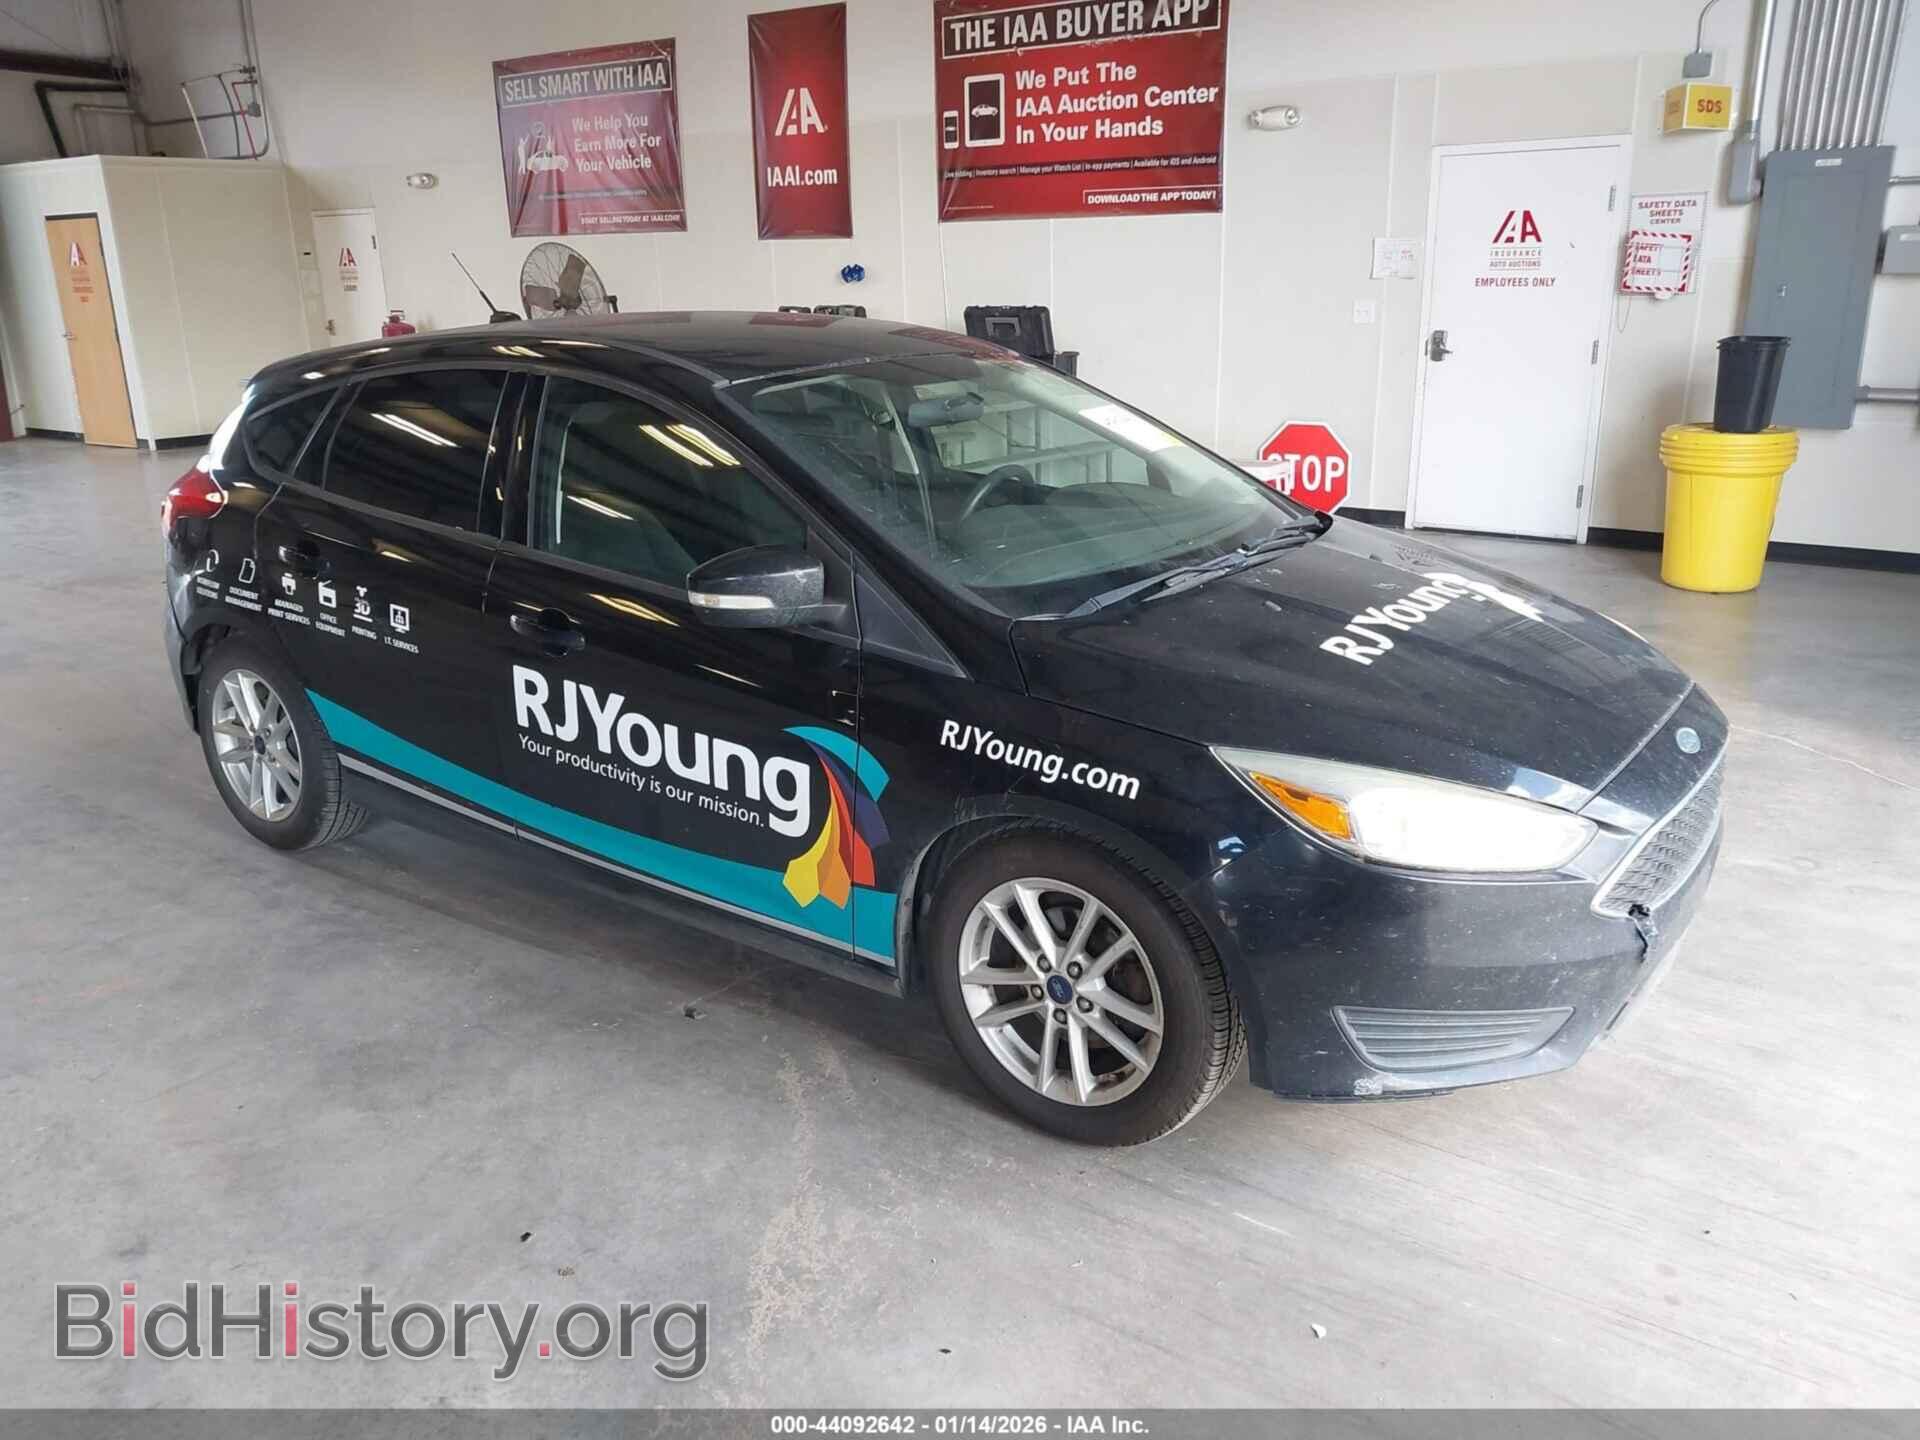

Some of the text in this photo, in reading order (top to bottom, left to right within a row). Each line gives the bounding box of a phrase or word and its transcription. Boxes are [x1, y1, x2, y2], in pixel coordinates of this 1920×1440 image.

[950, 0, 1209, 51] THE IAA BUYER APP
[505, 62, 667, 102] SELL SMART WITH IAA
[1016, 62, 1137, 90] We Put The
[1016, 85, 1219, 117] IAA Auction Center
[1697, 99, 1722, 114] SDS
[572, 113, 648, 131] We Help You
[1016, 117, 1164, 144] In Your Hands
[574, 134, 662, 152] Earn More For
[576, 154, 652, 173] Your Vehicle
[767, 165, 838, 188] IAAI.com
[1087, 193, 1140, 204] DOWNLOAD
[1141, 192, 1159, 202] THE
[1160, 191, 1179, 201] APP
[1638, 199, 1697, 209] SAFETY DATA
[1649, 209, 1684, 217] SHEETS
[1649, 217, 1681, 225] CENTER
[1474, 276, 1556, 288] EMPLOYEES ONLY
[512, 664, 810, 837] RJYoung
[940, 719, 1140, 800] RJYoung.com
[518, 733, 765, 829] Your productivity is our mission.
